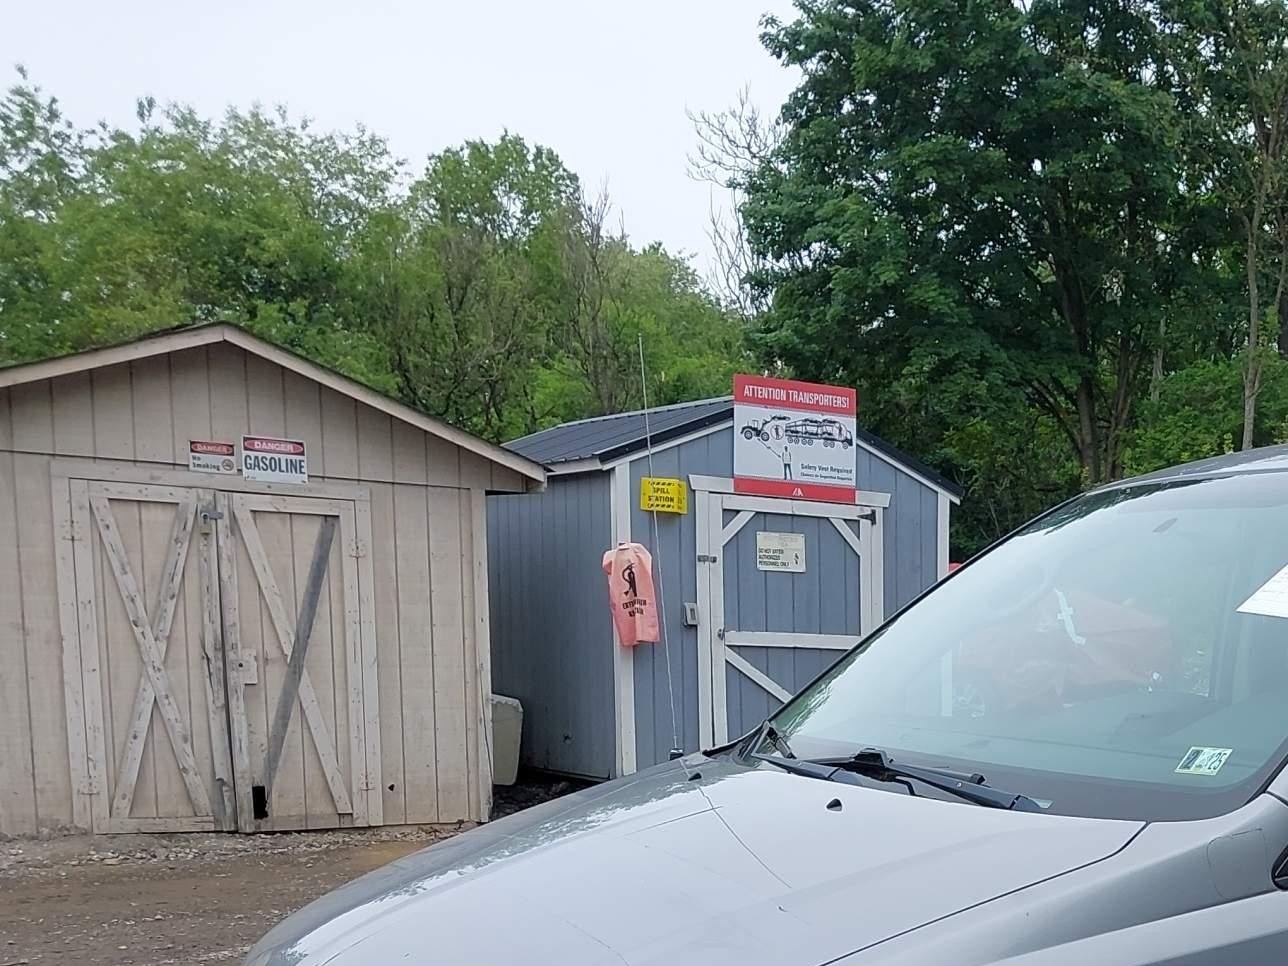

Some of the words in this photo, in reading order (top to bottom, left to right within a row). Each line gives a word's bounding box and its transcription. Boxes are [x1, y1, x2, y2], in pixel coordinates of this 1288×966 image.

[743, 385, 787, 401] ATTENTION
[788, 390, 850, 408] TRANSPORTERS!
[197, 444, 227, 453] DANGER
[254, 441, 294, 453] DANGER
[192, 462, 220, 471] Smoking
[244, 454, 306, 475] GASOLINE
